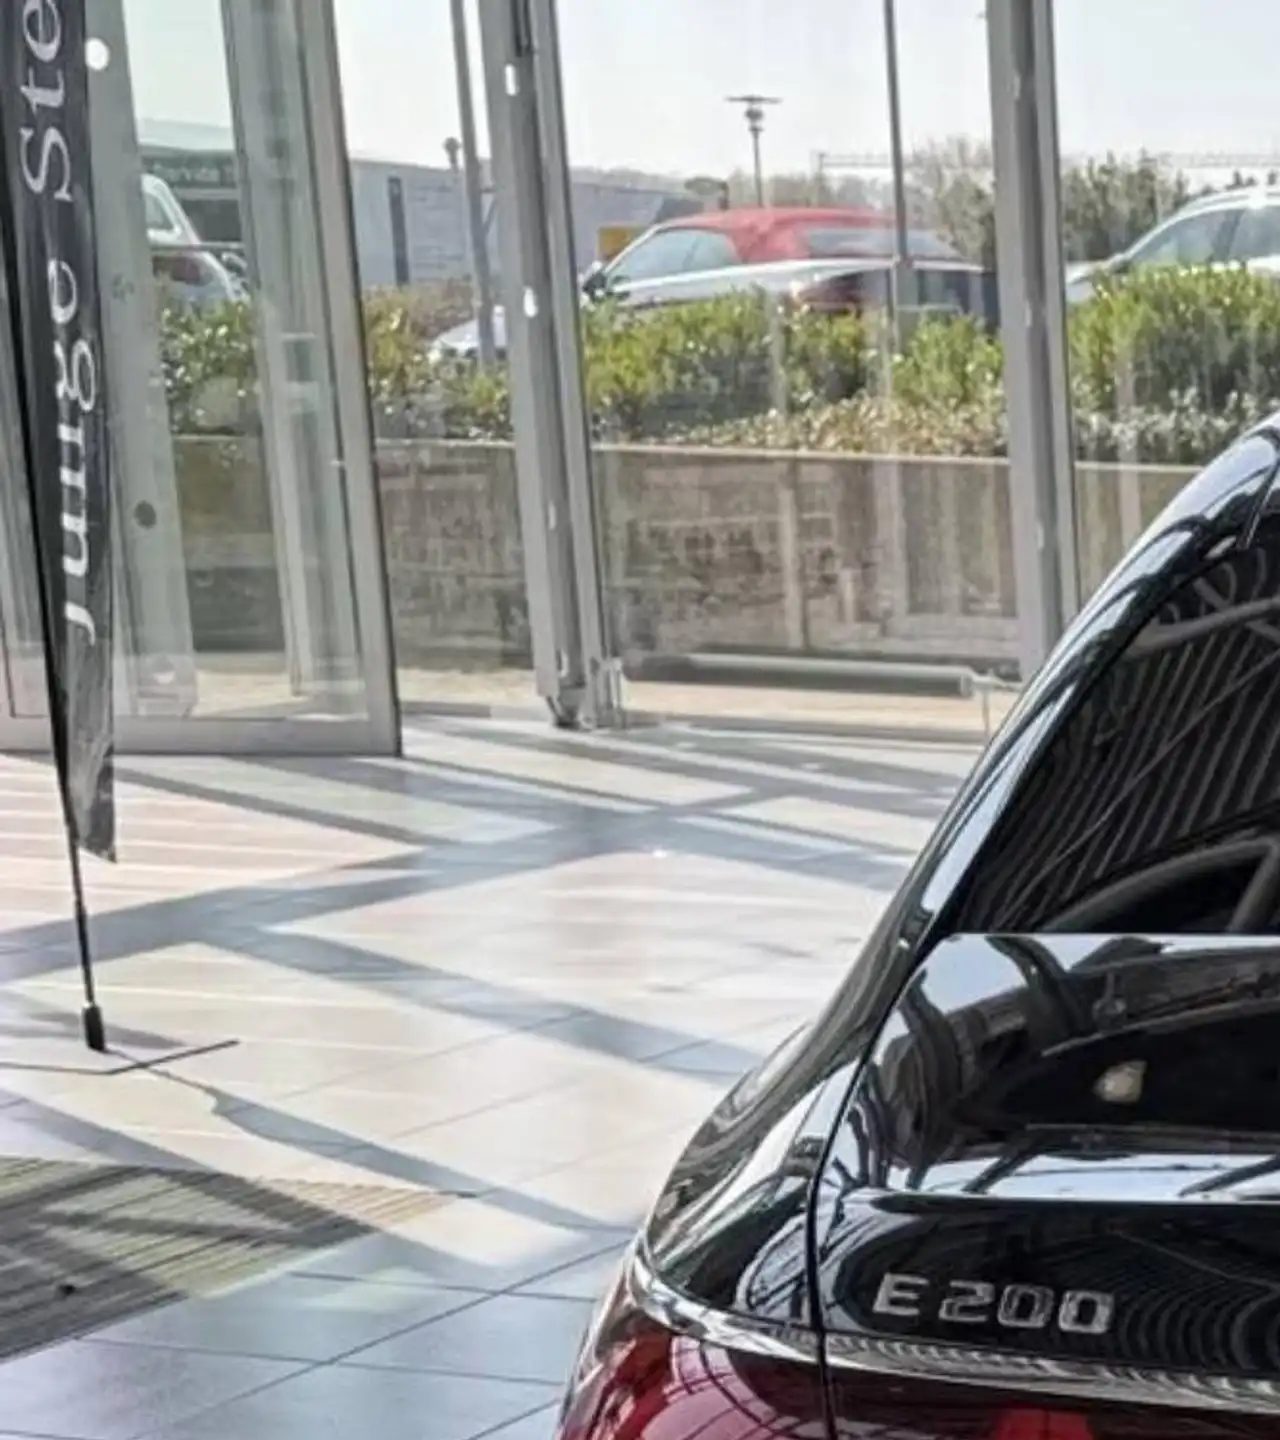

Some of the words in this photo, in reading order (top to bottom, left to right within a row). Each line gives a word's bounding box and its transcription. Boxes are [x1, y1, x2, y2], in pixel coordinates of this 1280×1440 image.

[48, 259, 96, 646] Junge
[872, 1272, 929, 1316] E
[938, 1279, 1115, 1334] 200
